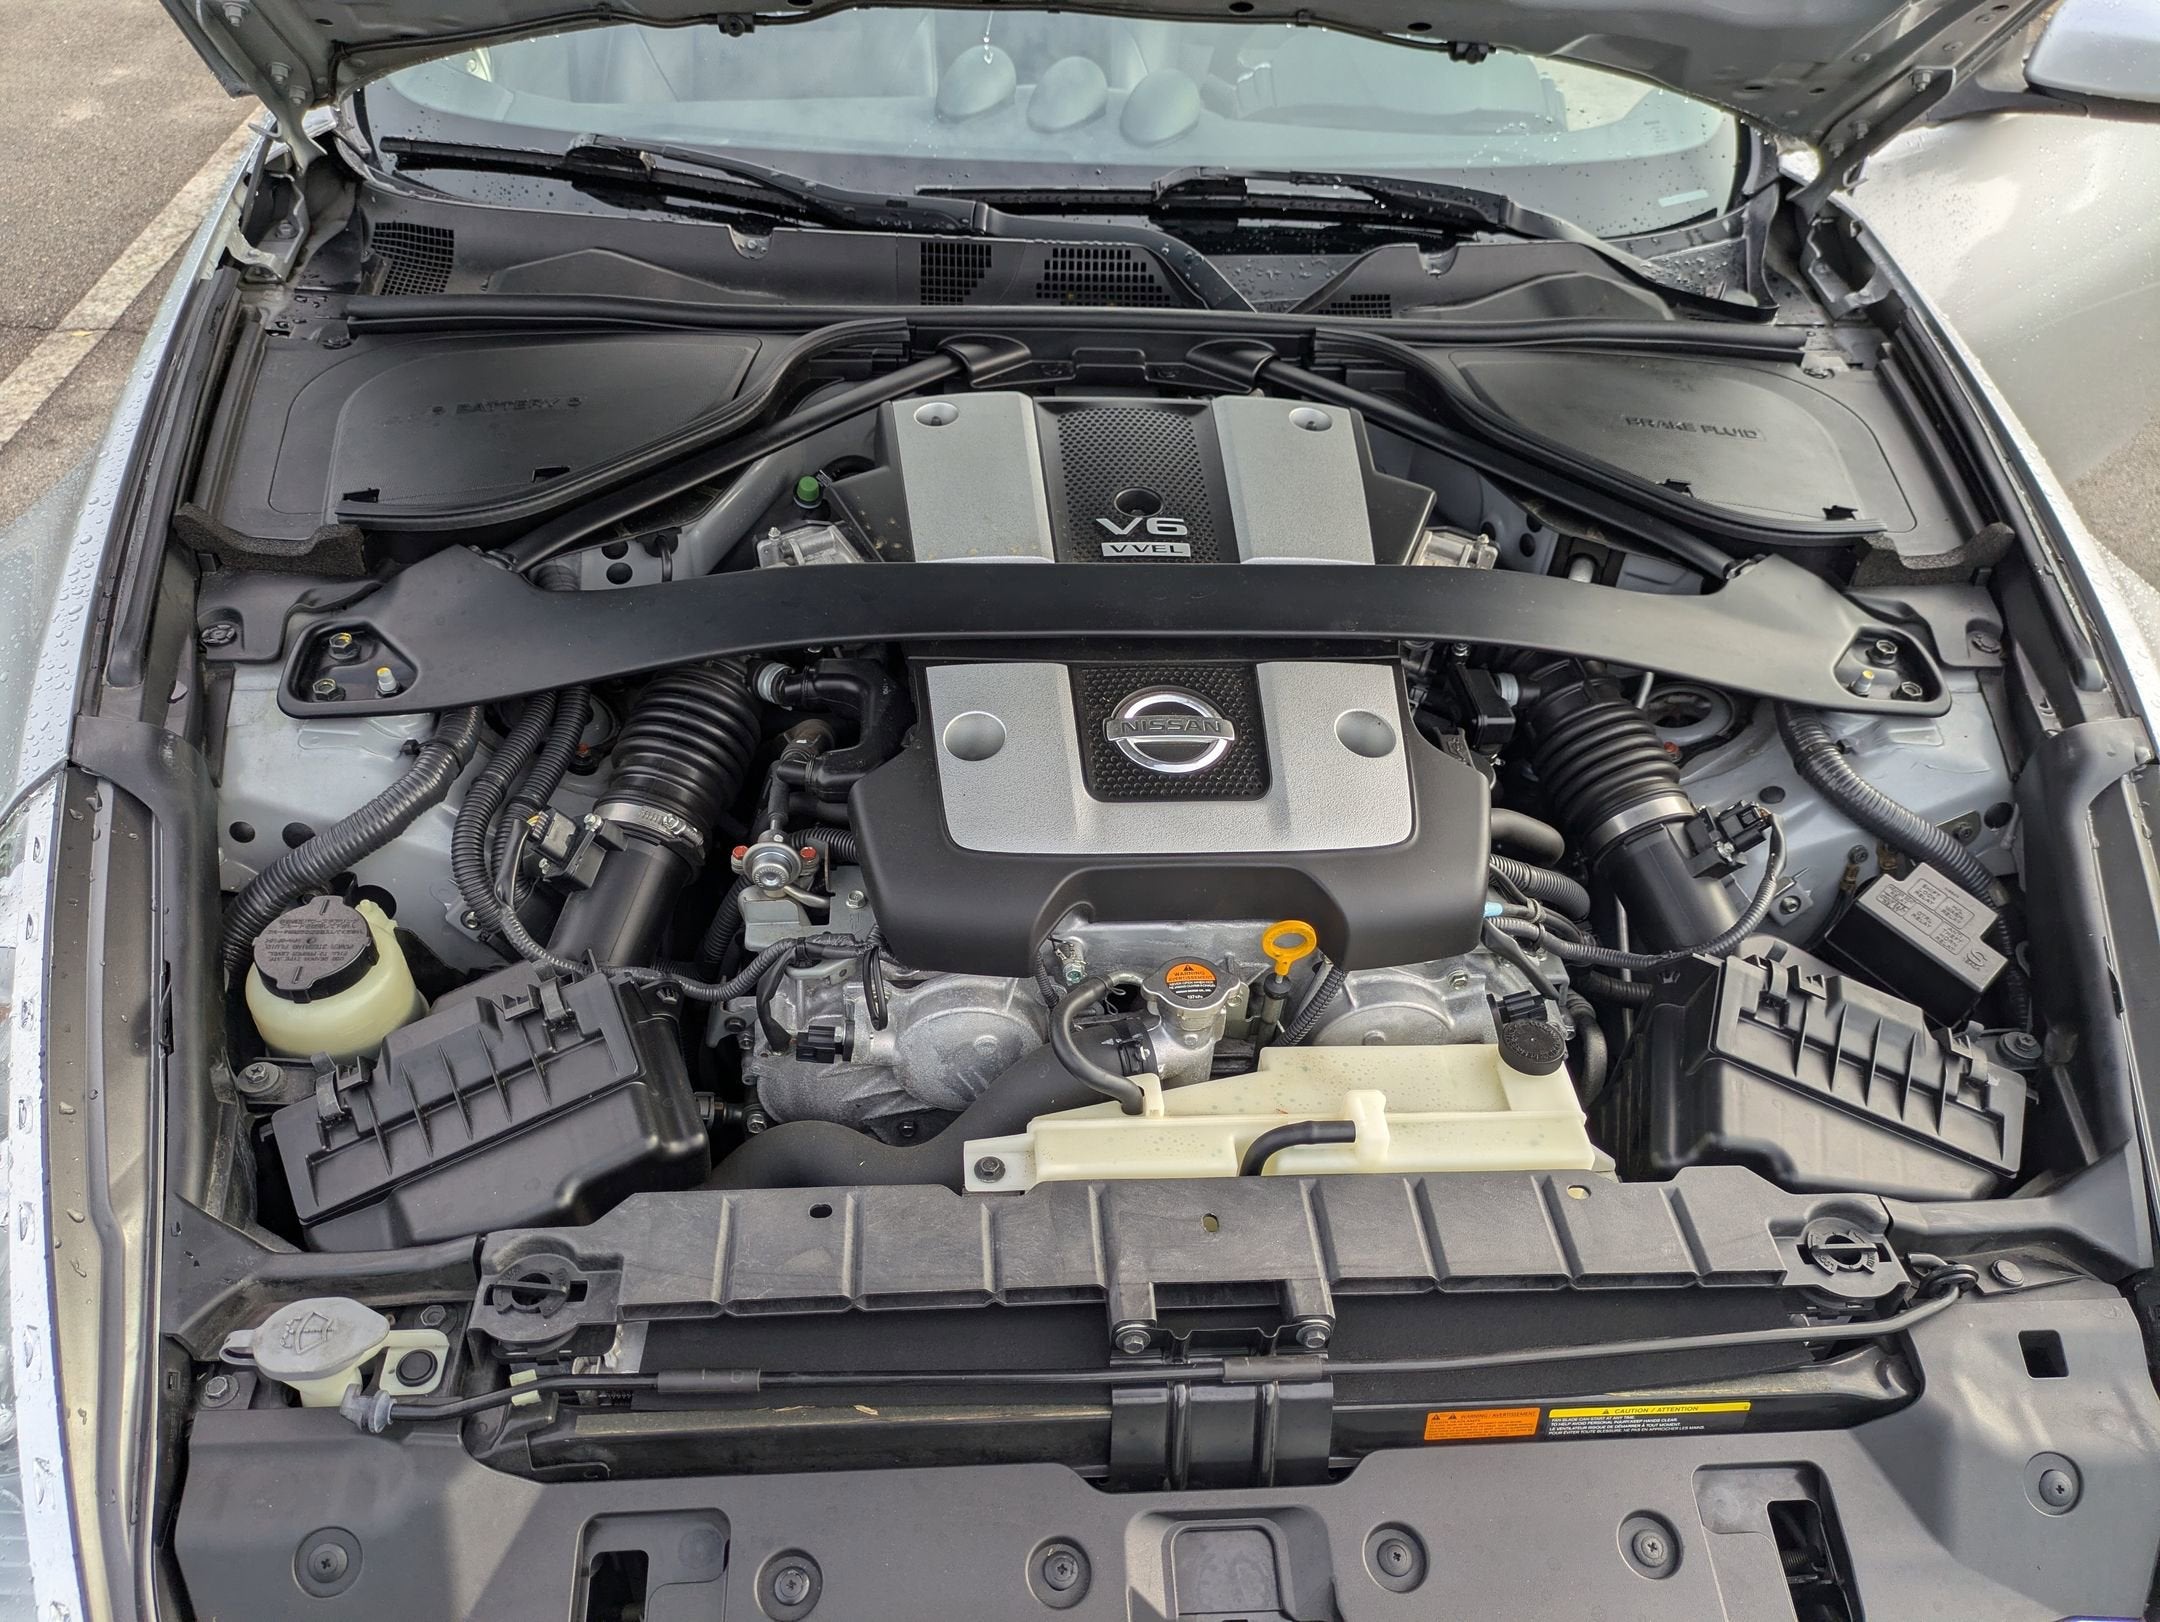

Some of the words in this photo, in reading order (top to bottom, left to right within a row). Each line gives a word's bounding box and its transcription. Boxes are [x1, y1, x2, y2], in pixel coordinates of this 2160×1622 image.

[1625, 417, 1697, 433] BRAKE
[1700, 424, 1757, 439] FLUID
[1095, 517, 1188, 536] V6
[1110, 544, 1183, 554] VVEL
[1121, 719, 1222, 733] NISSAN
